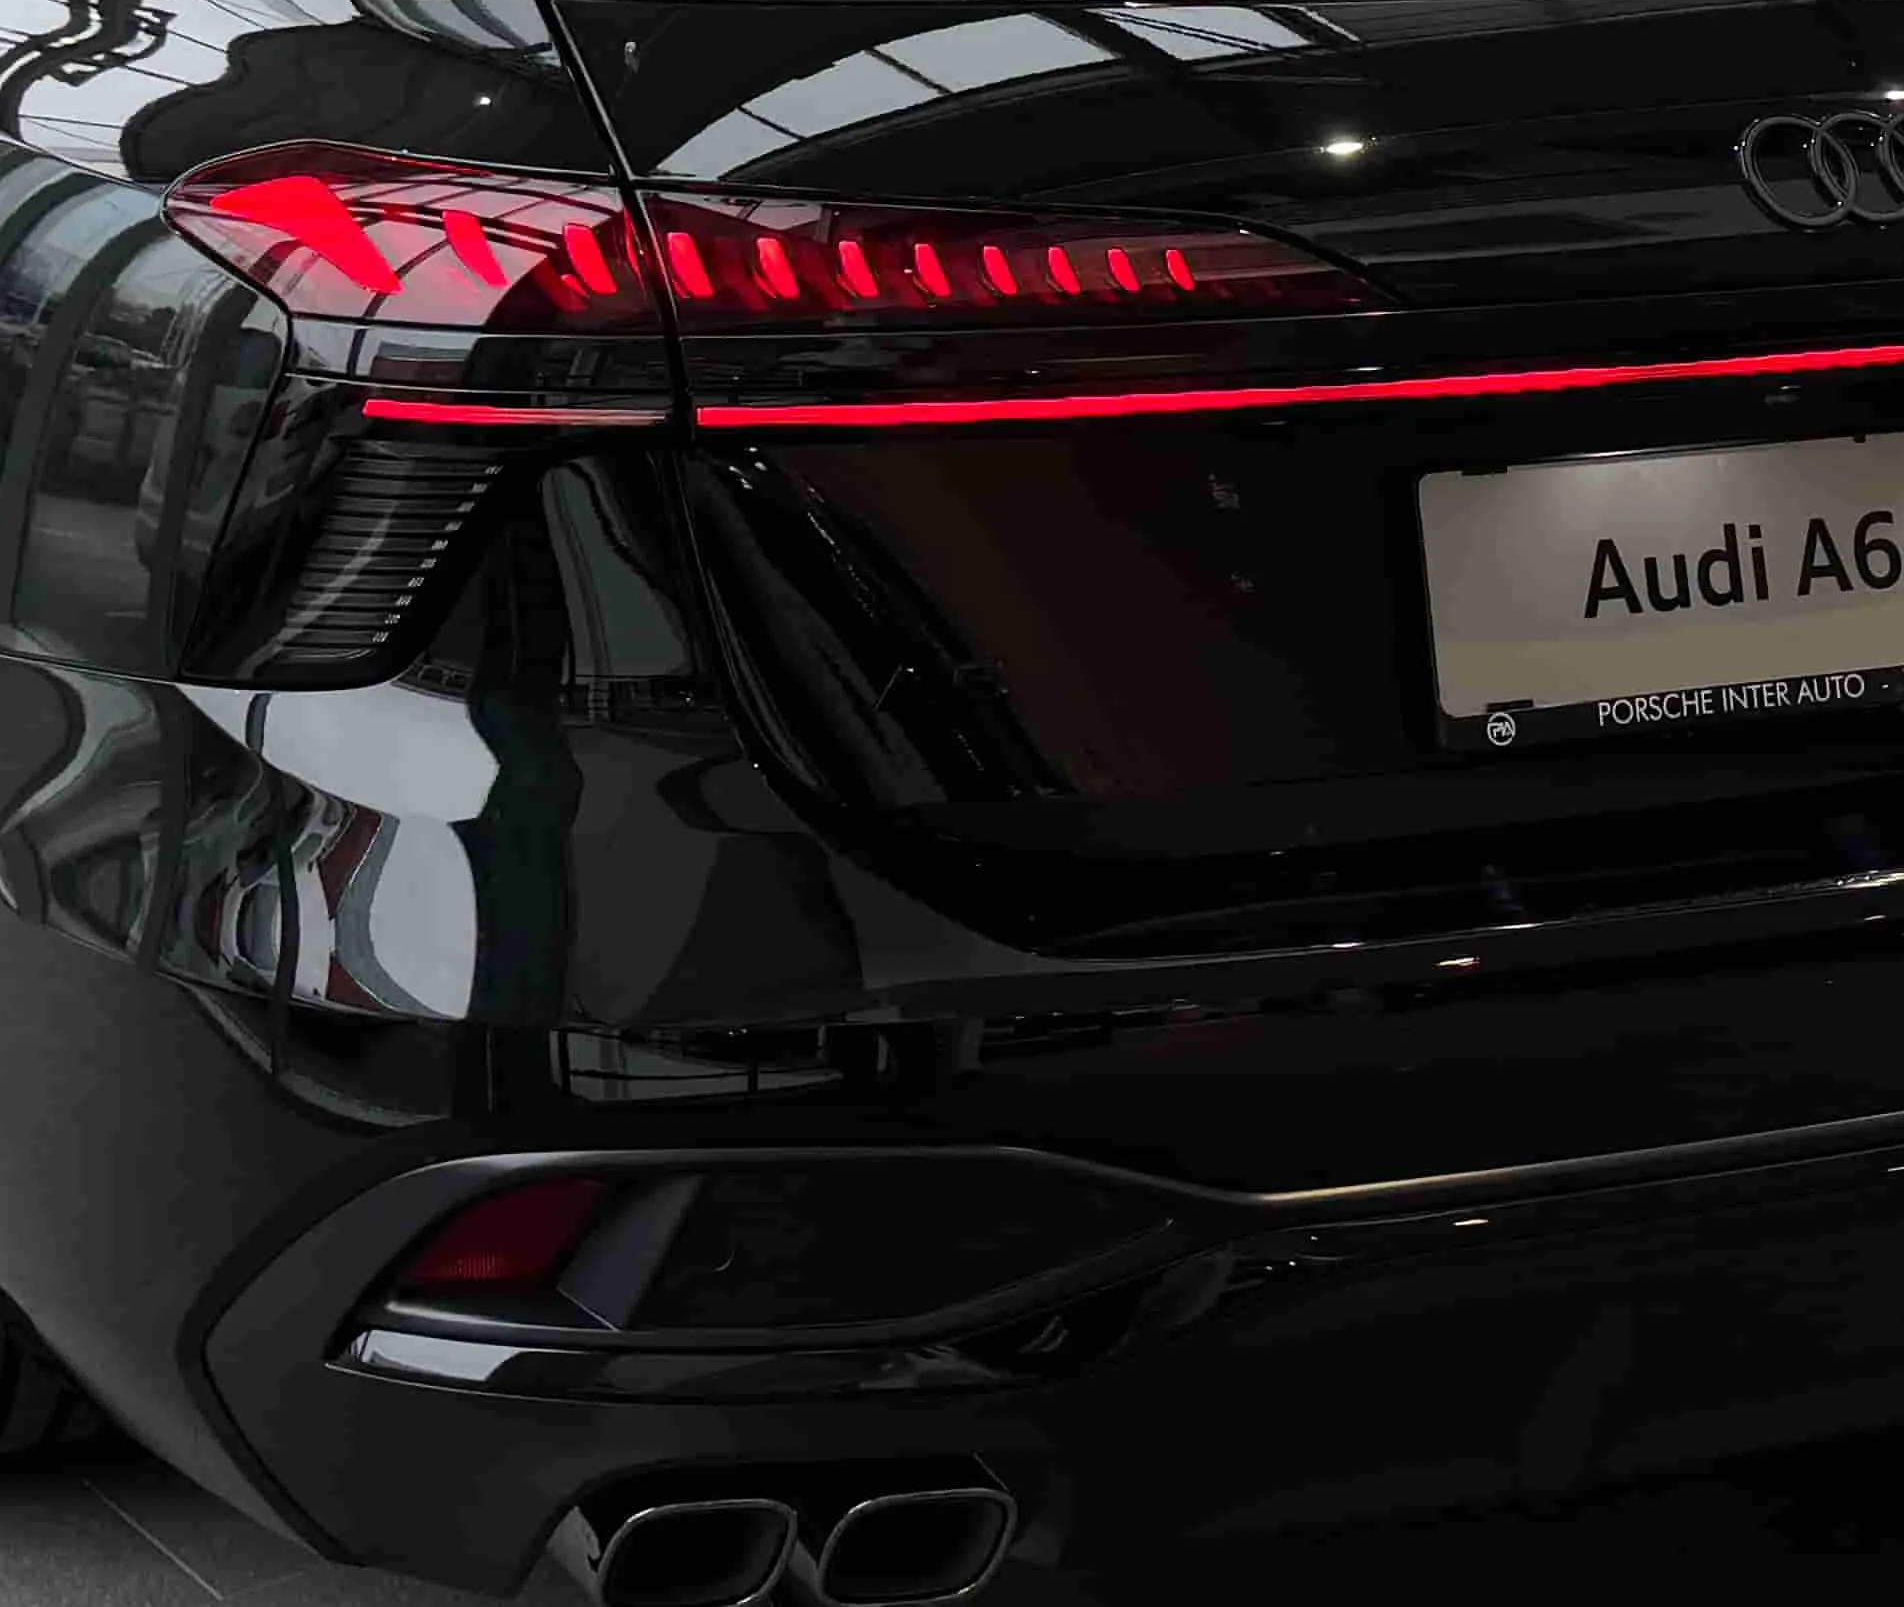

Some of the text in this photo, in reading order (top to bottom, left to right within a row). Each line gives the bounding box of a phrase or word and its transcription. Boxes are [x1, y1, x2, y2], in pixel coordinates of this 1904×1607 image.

[1584, 522, 1769, 620] Audi
[1797, 510, 1902, 597] A6
[1598, 689, 1713, 726] PORSCHE
[1722, 681, 1789, 712] INTER
[1797, 673, 1865, 705] AUTO
